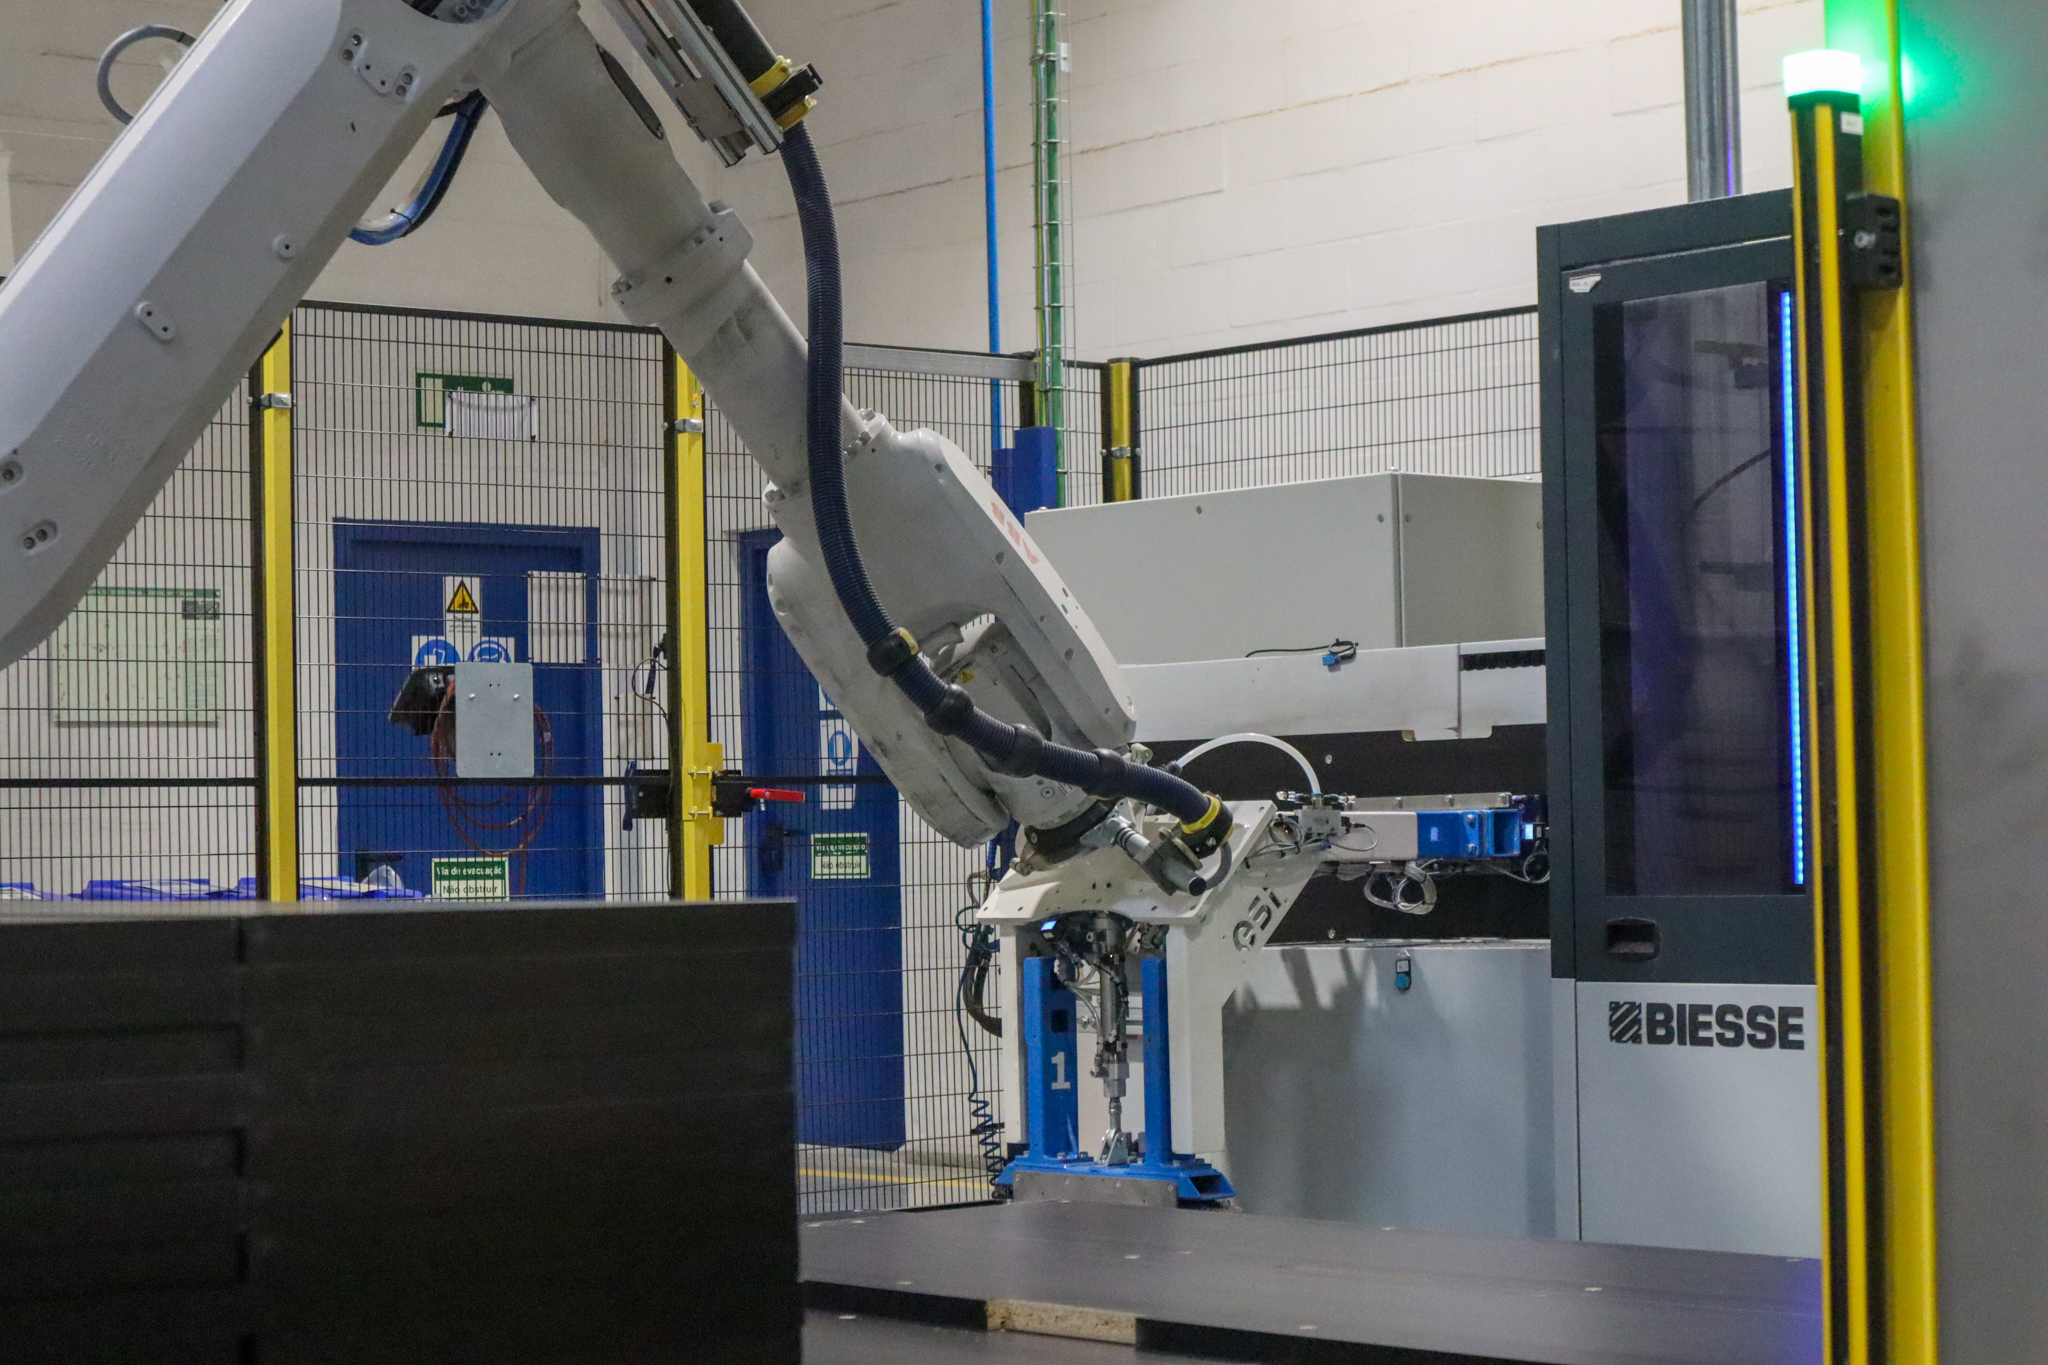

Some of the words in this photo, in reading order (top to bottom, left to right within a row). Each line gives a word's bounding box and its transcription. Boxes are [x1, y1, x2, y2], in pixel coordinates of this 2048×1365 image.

[443, 885, 460, 894] Não
[463, 885, 498, 894] obstruir
[1646, 1002, 1805, 1050] BIESSE
[1051, 1051, 1071, 1090] 1
